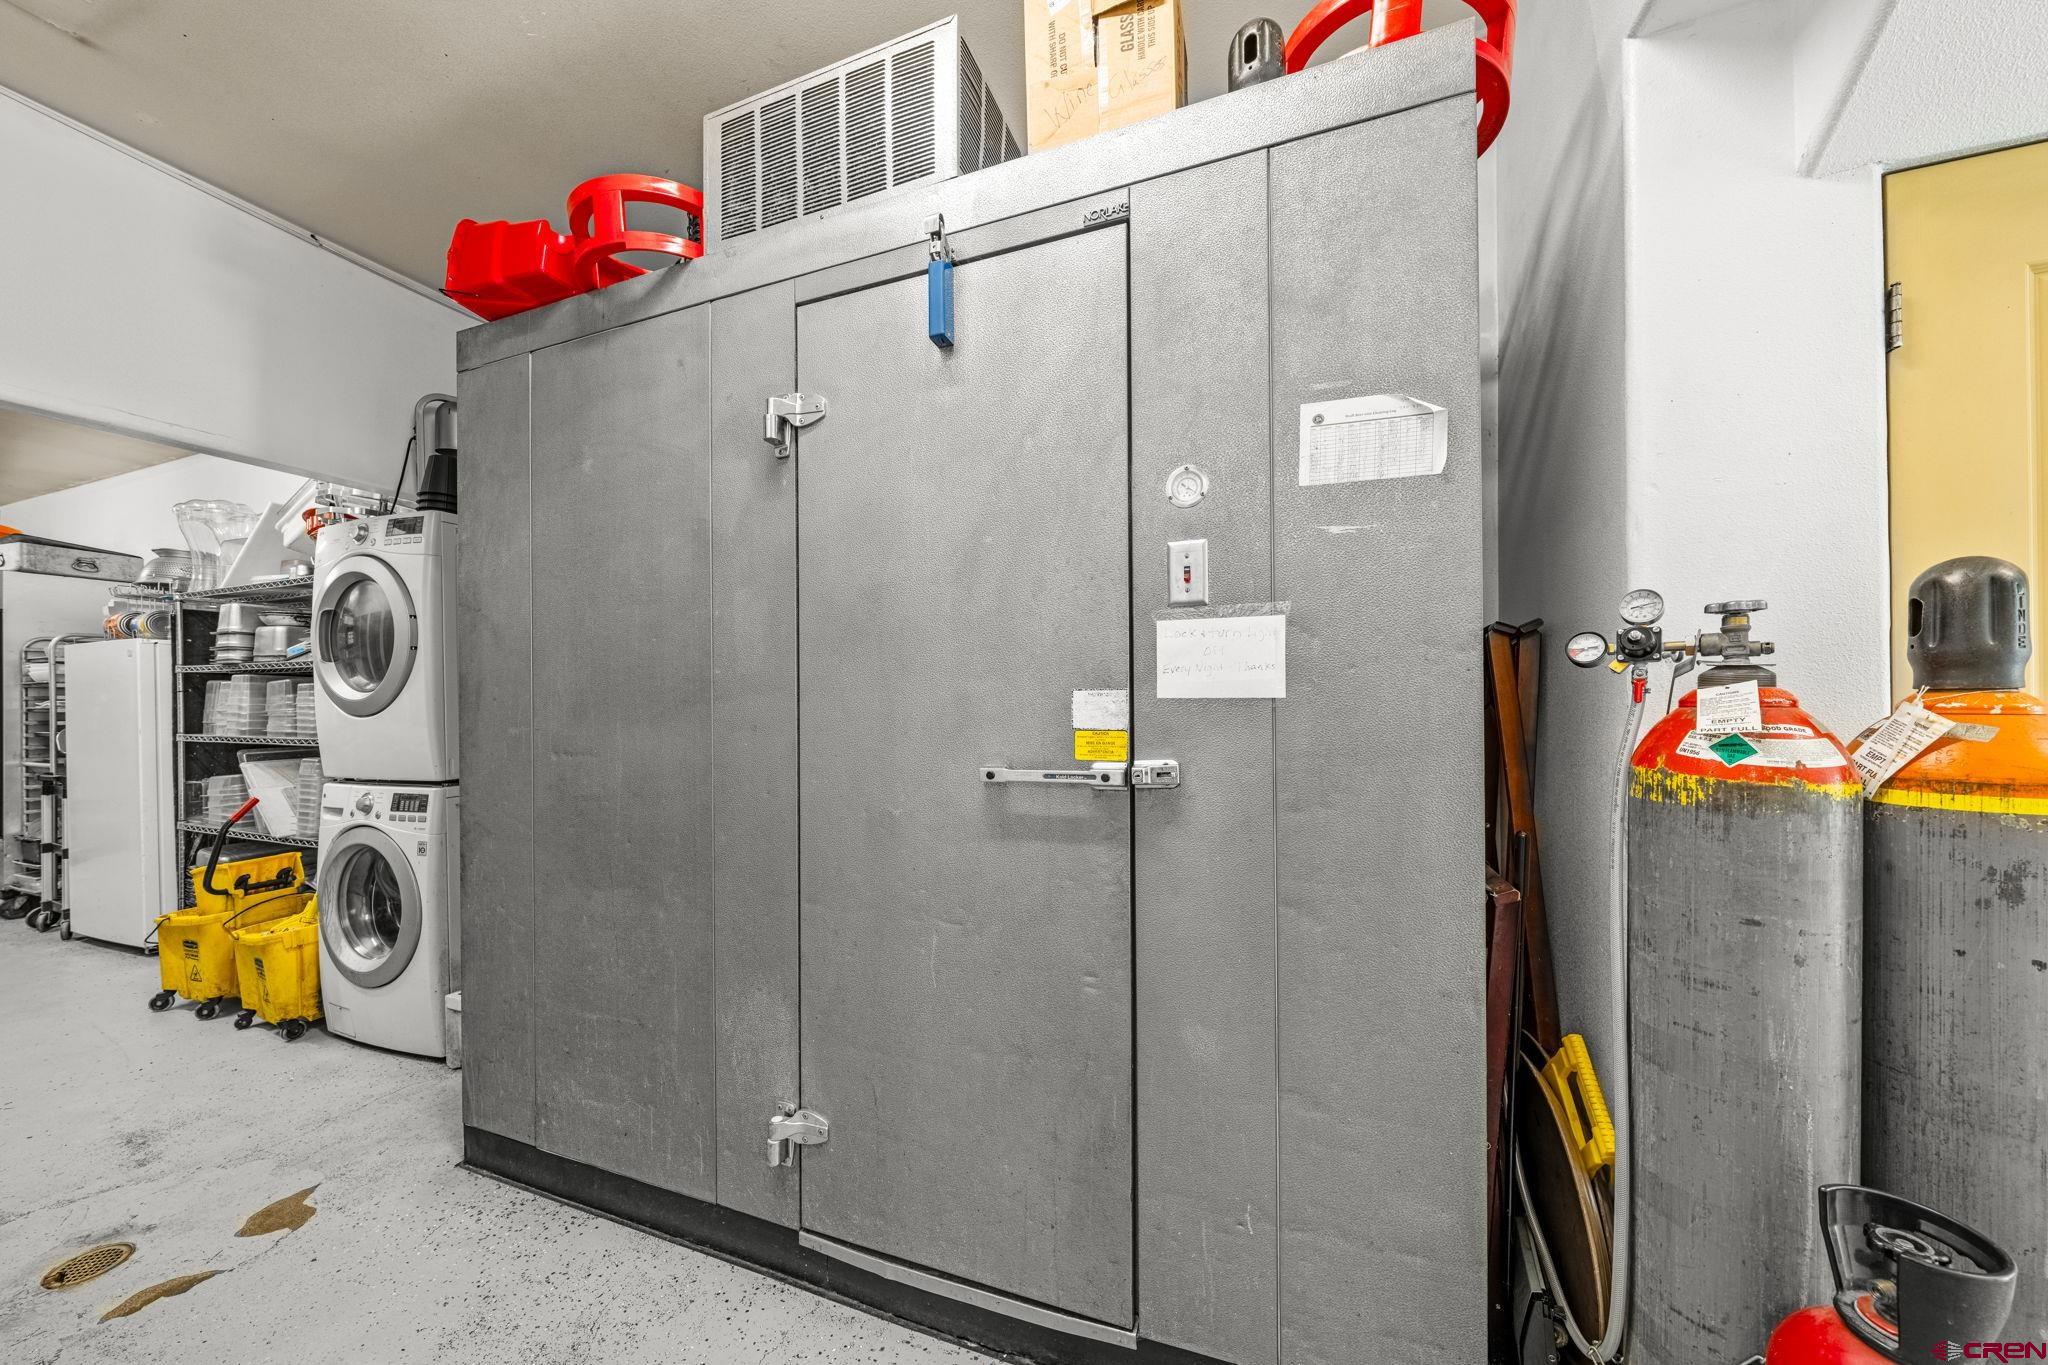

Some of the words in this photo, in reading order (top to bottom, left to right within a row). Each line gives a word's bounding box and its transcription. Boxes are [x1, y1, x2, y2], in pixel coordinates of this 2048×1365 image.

[1048, 19, 1056, 41] WITH
[1147, 15, 1156, 31] SIDE
[1059, 32, 1066, 44] DO
[1120, 14, 1135, 52] GLASS
[1147, 32, 1156, 48] THIS
[1049, 42, 1057, 68] SHARP
[1059, 46, 1068, 61] NOT
[1083, 202, 1129, 223] NORLAKE
[1162, 664, 1191, 676] Every
[1783, 726, 1808, 734] GRADE
[1679, 747, 1700, 755] UN1956
